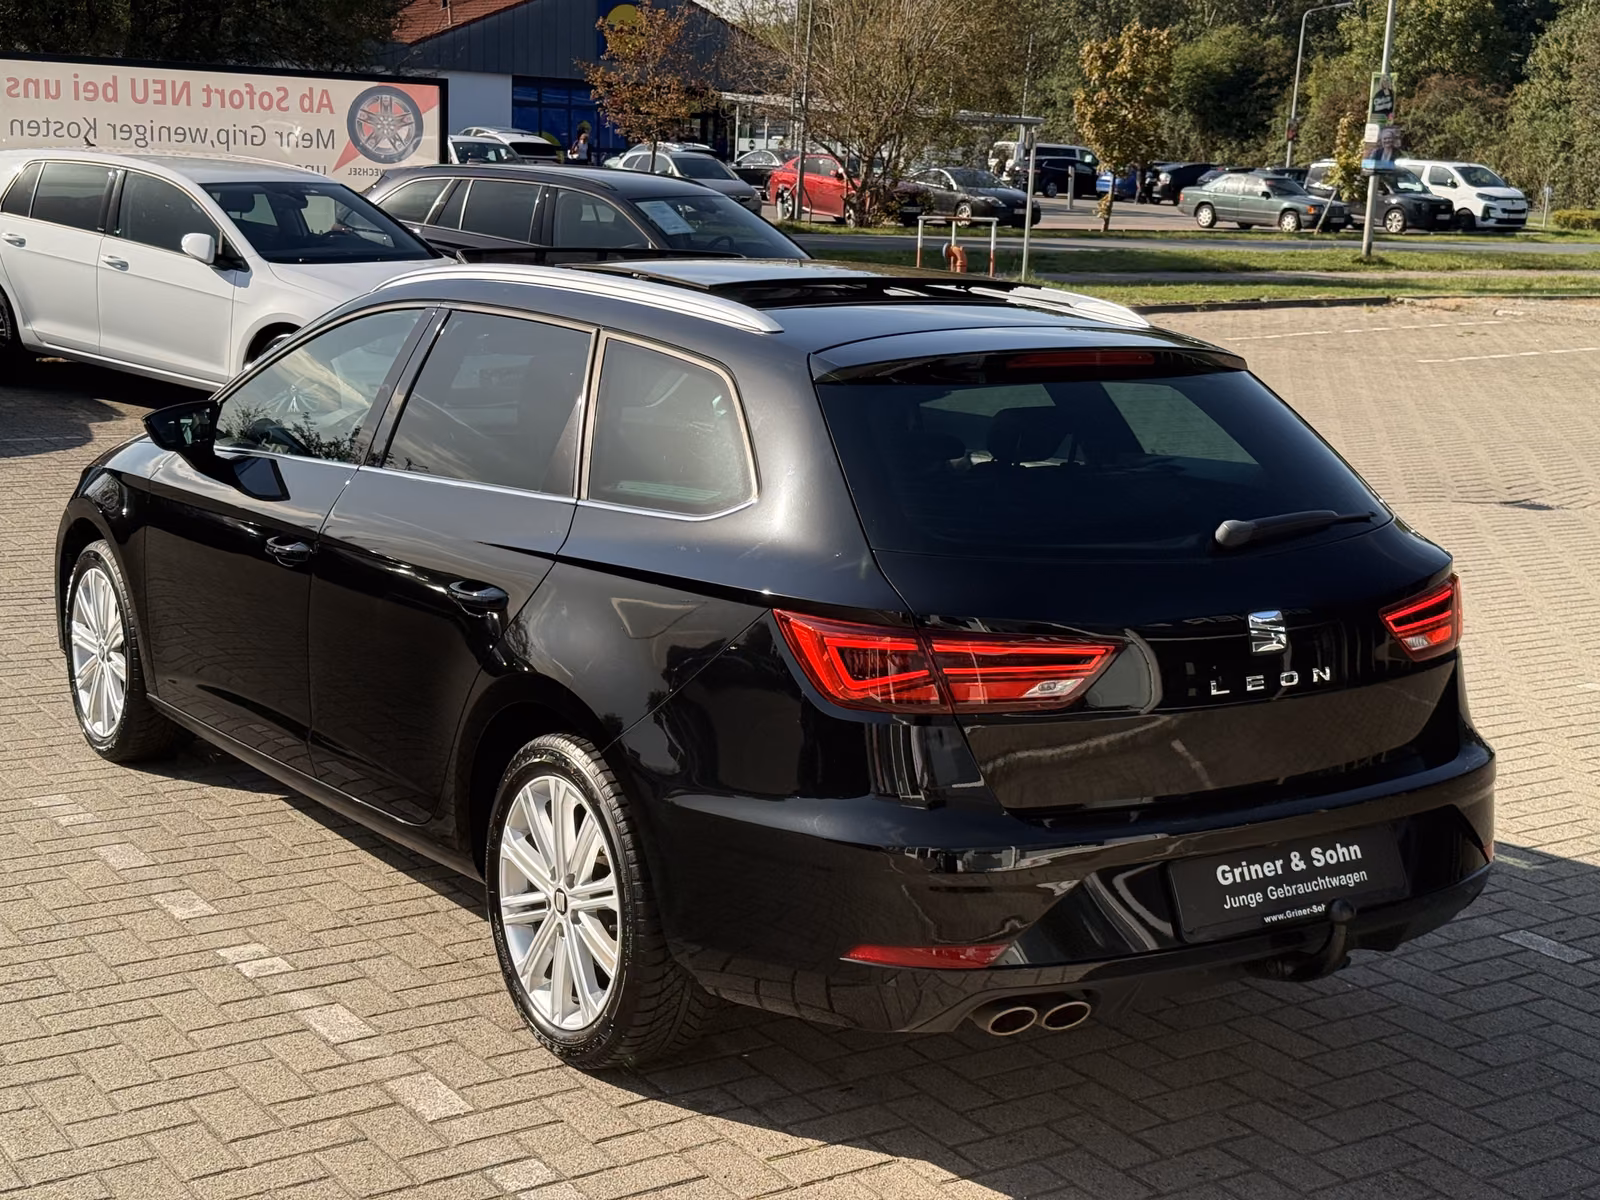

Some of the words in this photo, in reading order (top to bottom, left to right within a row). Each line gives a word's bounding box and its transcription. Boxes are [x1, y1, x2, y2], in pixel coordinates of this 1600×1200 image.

[1210, 666, 1331, 696] LEON
[1216, 857, 1284, 886] Griner
[1290, 851, 1307, 872] &
[1310, 842, 1363, 868] Sohn
[1223, 890, 1264, 909] Junge
[1267, 868, 1368, 900] Gebrauchtwagen
